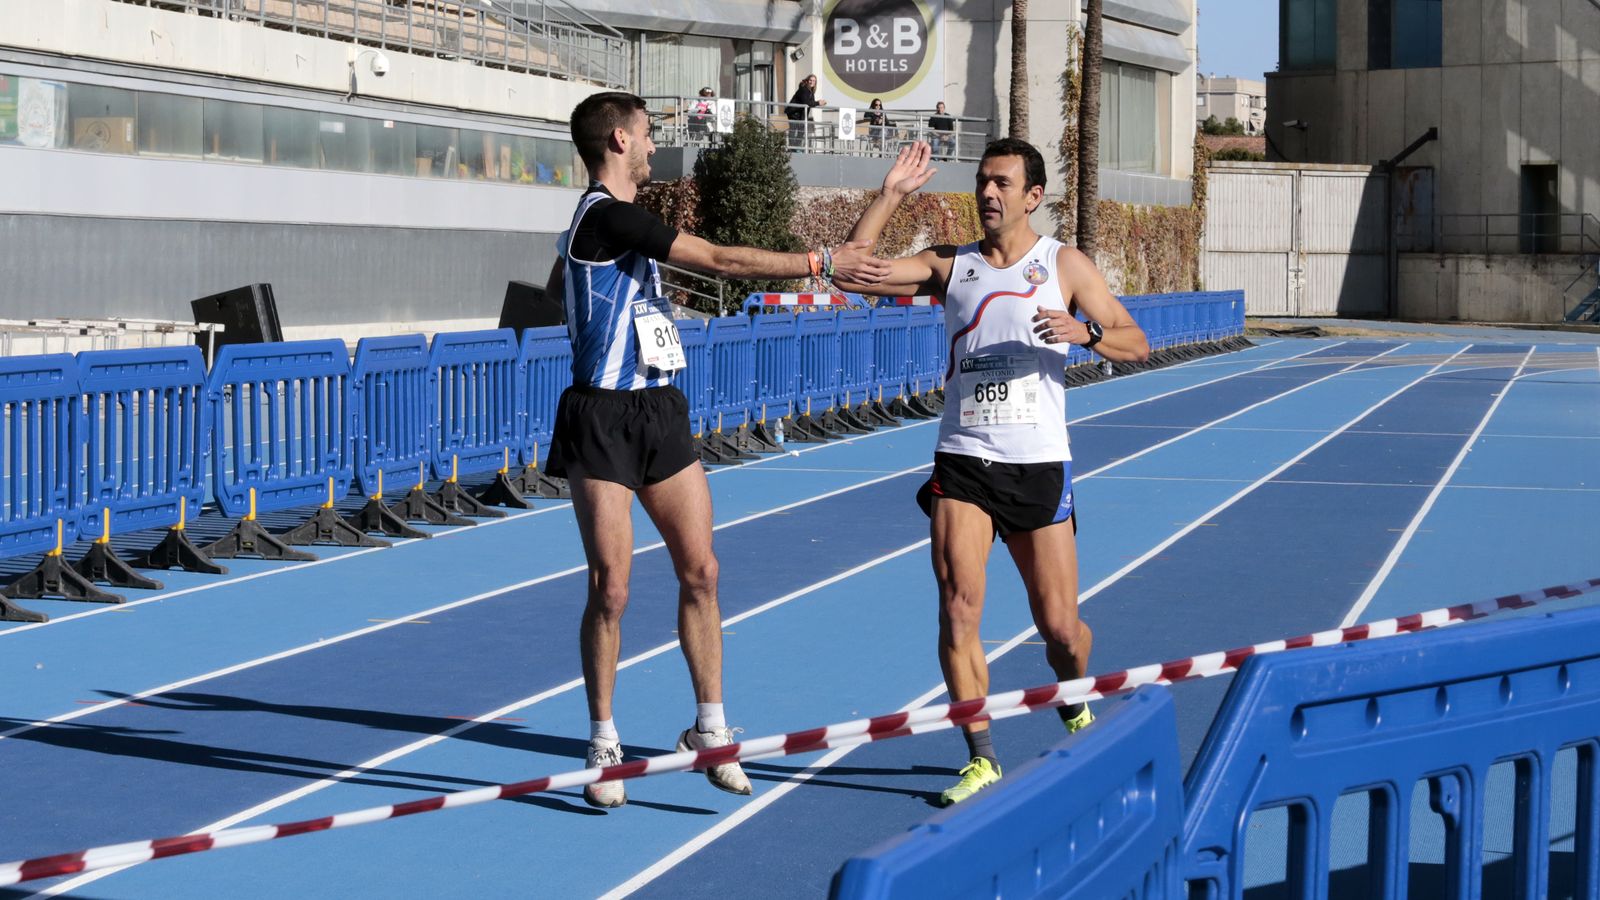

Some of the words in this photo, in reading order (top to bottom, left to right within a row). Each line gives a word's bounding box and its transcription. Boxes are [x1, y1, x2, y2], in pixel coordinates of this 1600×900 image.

[834, 18, 922, 55] B&B
[846, 59, 908, 72] HOTELS
[634, 303, 647, 314] XXV
[654, 325, 679, 347] 810
[962, 359, 974, 369] XXV
[981, 369, 1015, 377] ANTONIO
[975, 382, 1008, 402] 669
